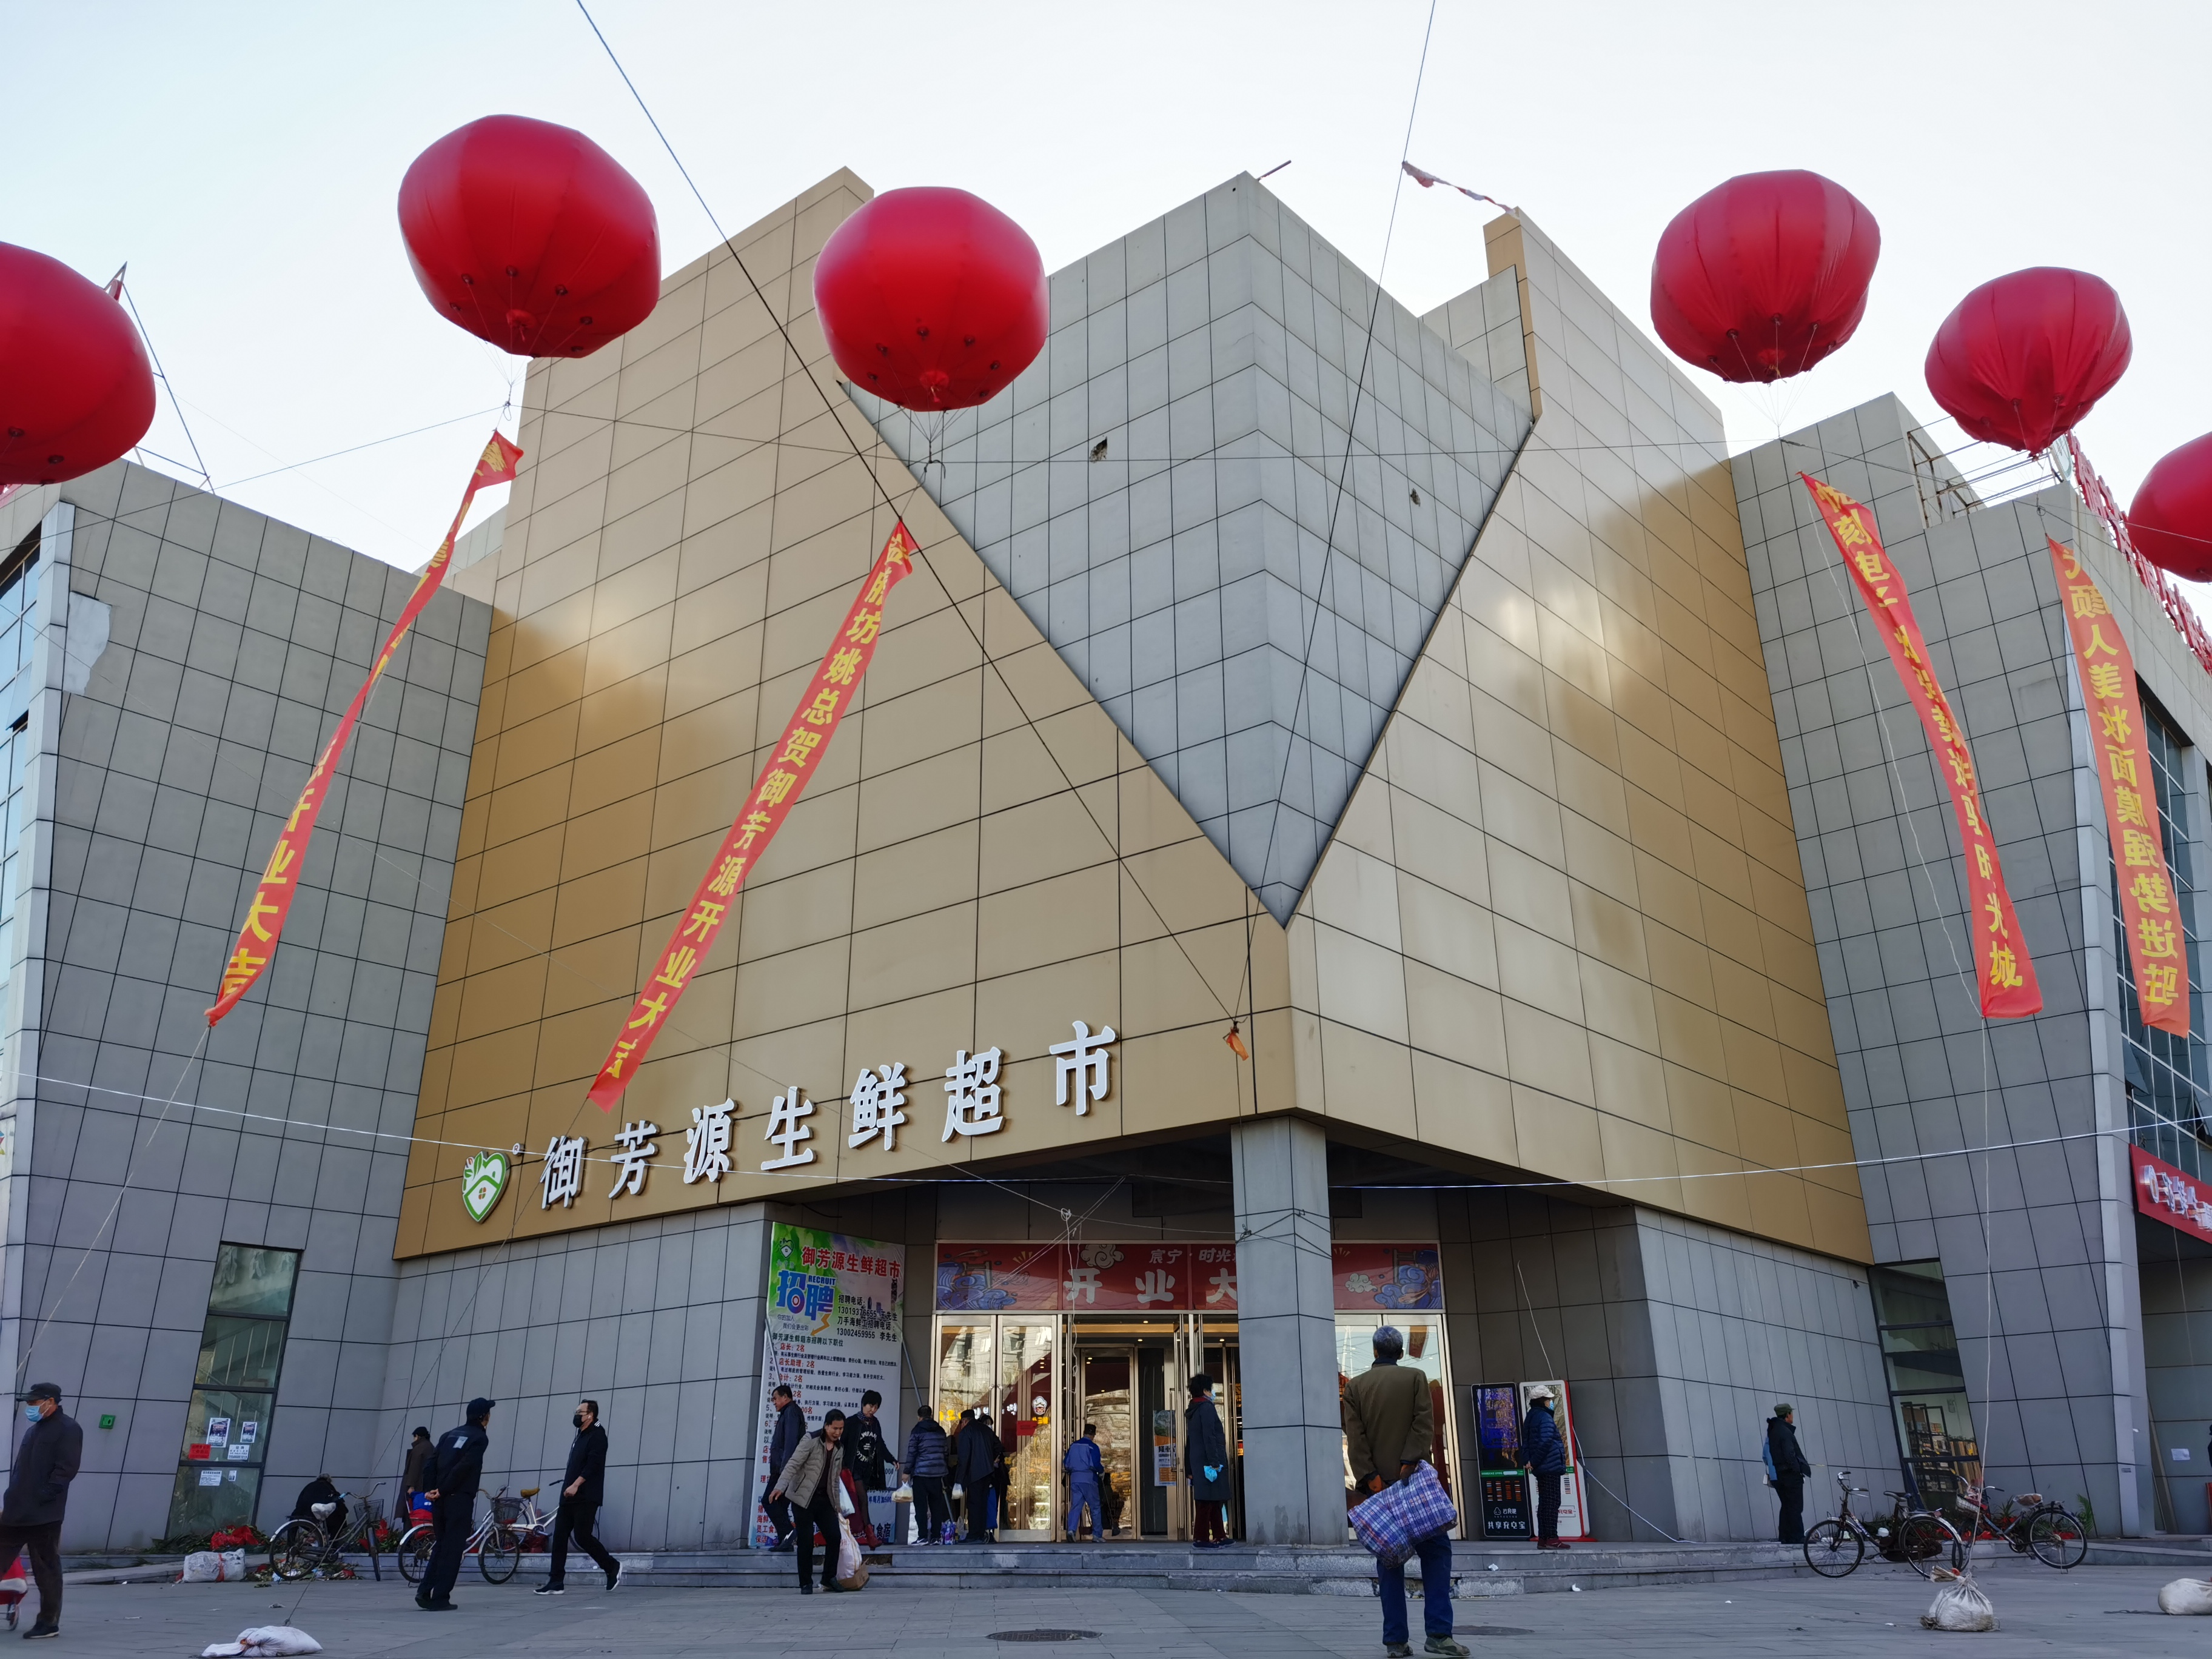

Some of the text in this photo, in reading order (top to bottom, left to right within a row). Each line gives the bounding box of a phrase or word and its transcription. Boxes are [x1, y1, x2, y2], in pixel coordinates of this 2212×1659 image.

[540, 1021, 1118, 1210] 御芳源生鲜超市
[802, 1247, 900, 1279] 御芳源生鲜超市
[1149, 1248, 1236, 1264] 宸宁·时光
[808, 1275, 836, 1285] RECRUIT
[776, 1270, 834, 1321] 招聘
[838, 1306, 877, 1318] 13019376655
[783, 1322, 809, 1331] 我们会更出彩
[837, 1327, 897, 1342] 13002459955 李先生
[1488, 1521, 1526, 1530] 共享充电宝
